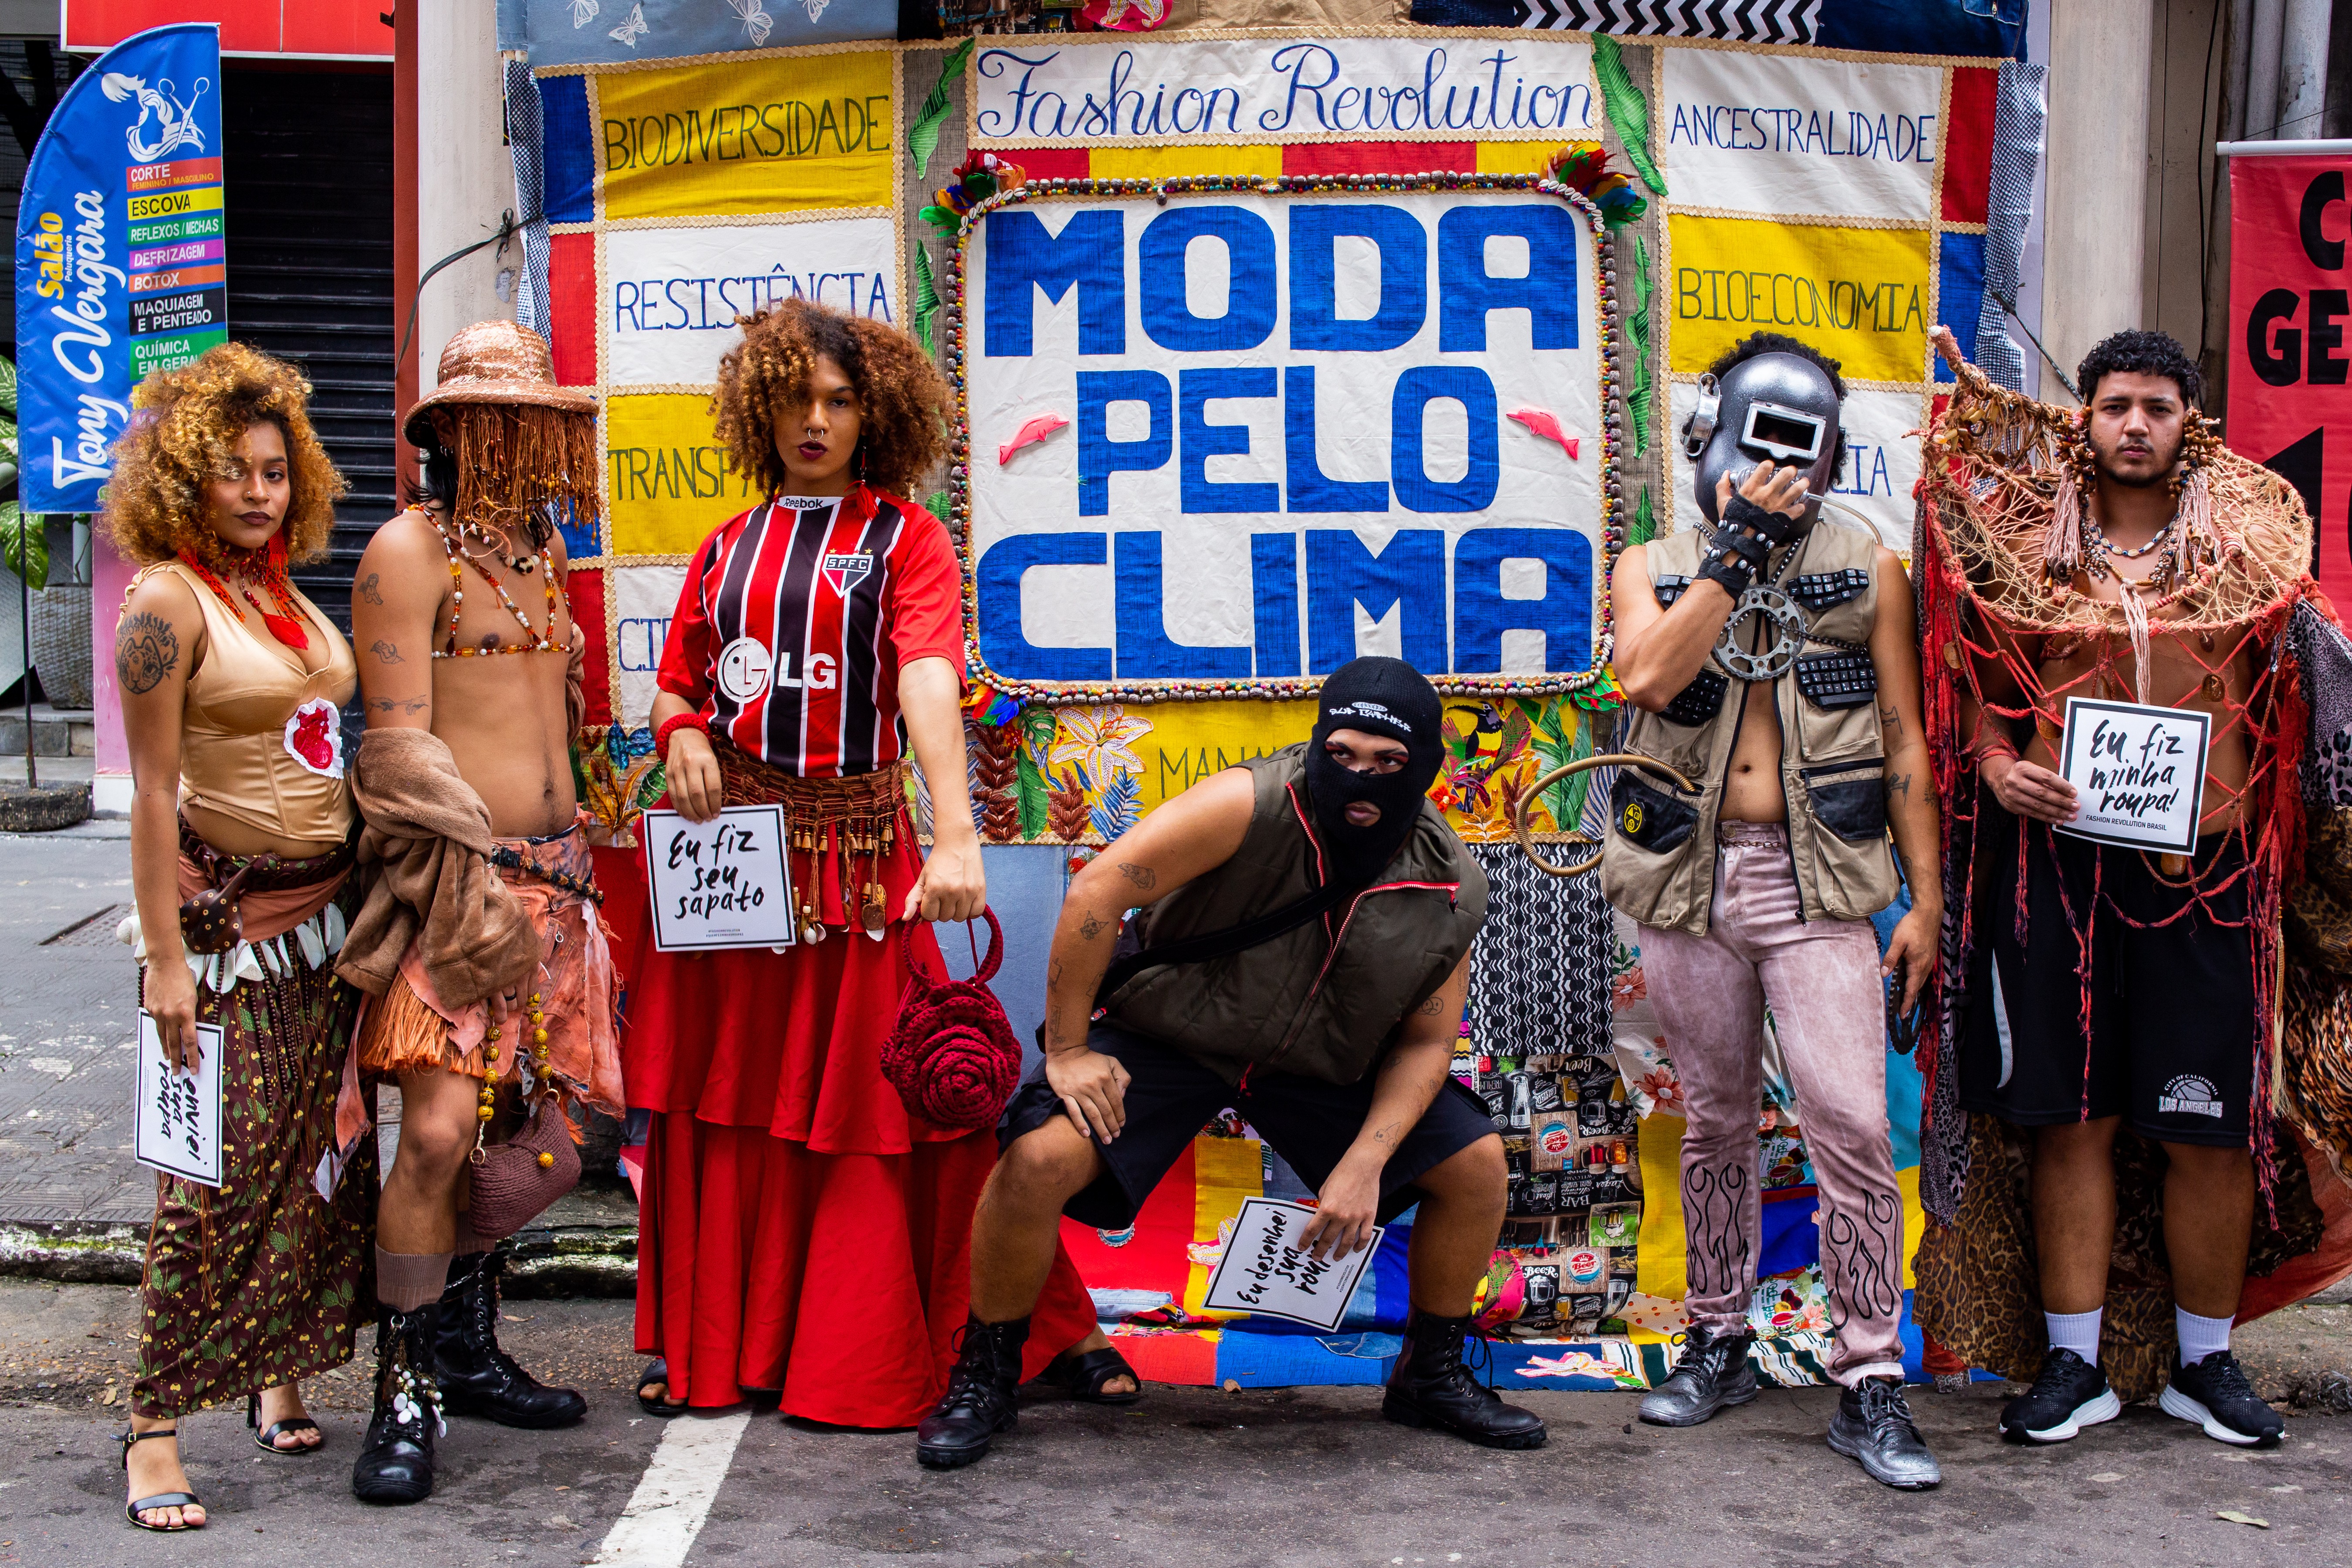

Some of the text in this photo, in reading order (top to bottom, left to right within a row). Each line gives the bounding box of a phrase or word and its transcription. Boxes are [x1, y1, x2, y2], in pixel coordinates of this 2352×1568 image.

[976, 44, 1593, 137] Fashion Revolution
[605, 95, 890, 171] BIODIVERSIDADE
[1671, 103, 1935, 162] ANCESTRALIDADE
[131, 164, 170, 182] CORTE
[132, 179, 166, 189] FEMININO
[173, 173, 214, 184] MASCULINO
[132, 194, 191, 216] ESCOVA
[2299, 171, 2352, 270] C
[131, 223, 179, 242] REFLEXOS
[186, 218, 219, 234] MECHAS
[34, 212, 64, 300] Salão
[65, 235, 74, 282] Peluqueria
[134, 244, 205, 267] DEFRIZAGEM
[134, 272, 179, 291] BOTOX
[984, 204, 1578, 357] MODA
[134, 294, 203, 317] MAQUIAGEM
[1679, 267, 1924, 332] BIOECONOMIA
[138, 309, 212, 332] E PENTEADO
[51, 190, 128, 489] Tony Vergara
[135, 339, 190, 359] QUÍMICA
[139, 360, 158, 375] EM
[1075, 365, 1499, 516] PELO
[783, 498, 823, 508] Reebok
[828, 559, 868, 569] SPFC
[977, 527, 1593, 681] CLIMA
[778, 652, 836, 689] LG
[2090, 720, 2184, 770] Eu fiz
[2089, 759, 2176, 790] minha
[2099, 788, 2179, 818] roupa!
[2086, 814, 2167, 831] FASHION REVOLUTION BRASIL
[668, 824, 760, 870] Eu fiz
[690, 865, 739, 892] seu
[674, 880, 764, 919] sapato
[157, 1061, 171, 1139] roupa
[170, 1075, 182, 1125] sua
[2164, 1078, 2176, 1091] CITY
[2185, 1074, 2218, 1095] CALIFORNIA
[183, 1077, 207, 1166] enviei
[2159, 1096, 2223, 1118] LOS ANGELES
[1237, 1208, 1288, 1304] Eu desenhei
[1274, 1246, 1304, 1283] sua
